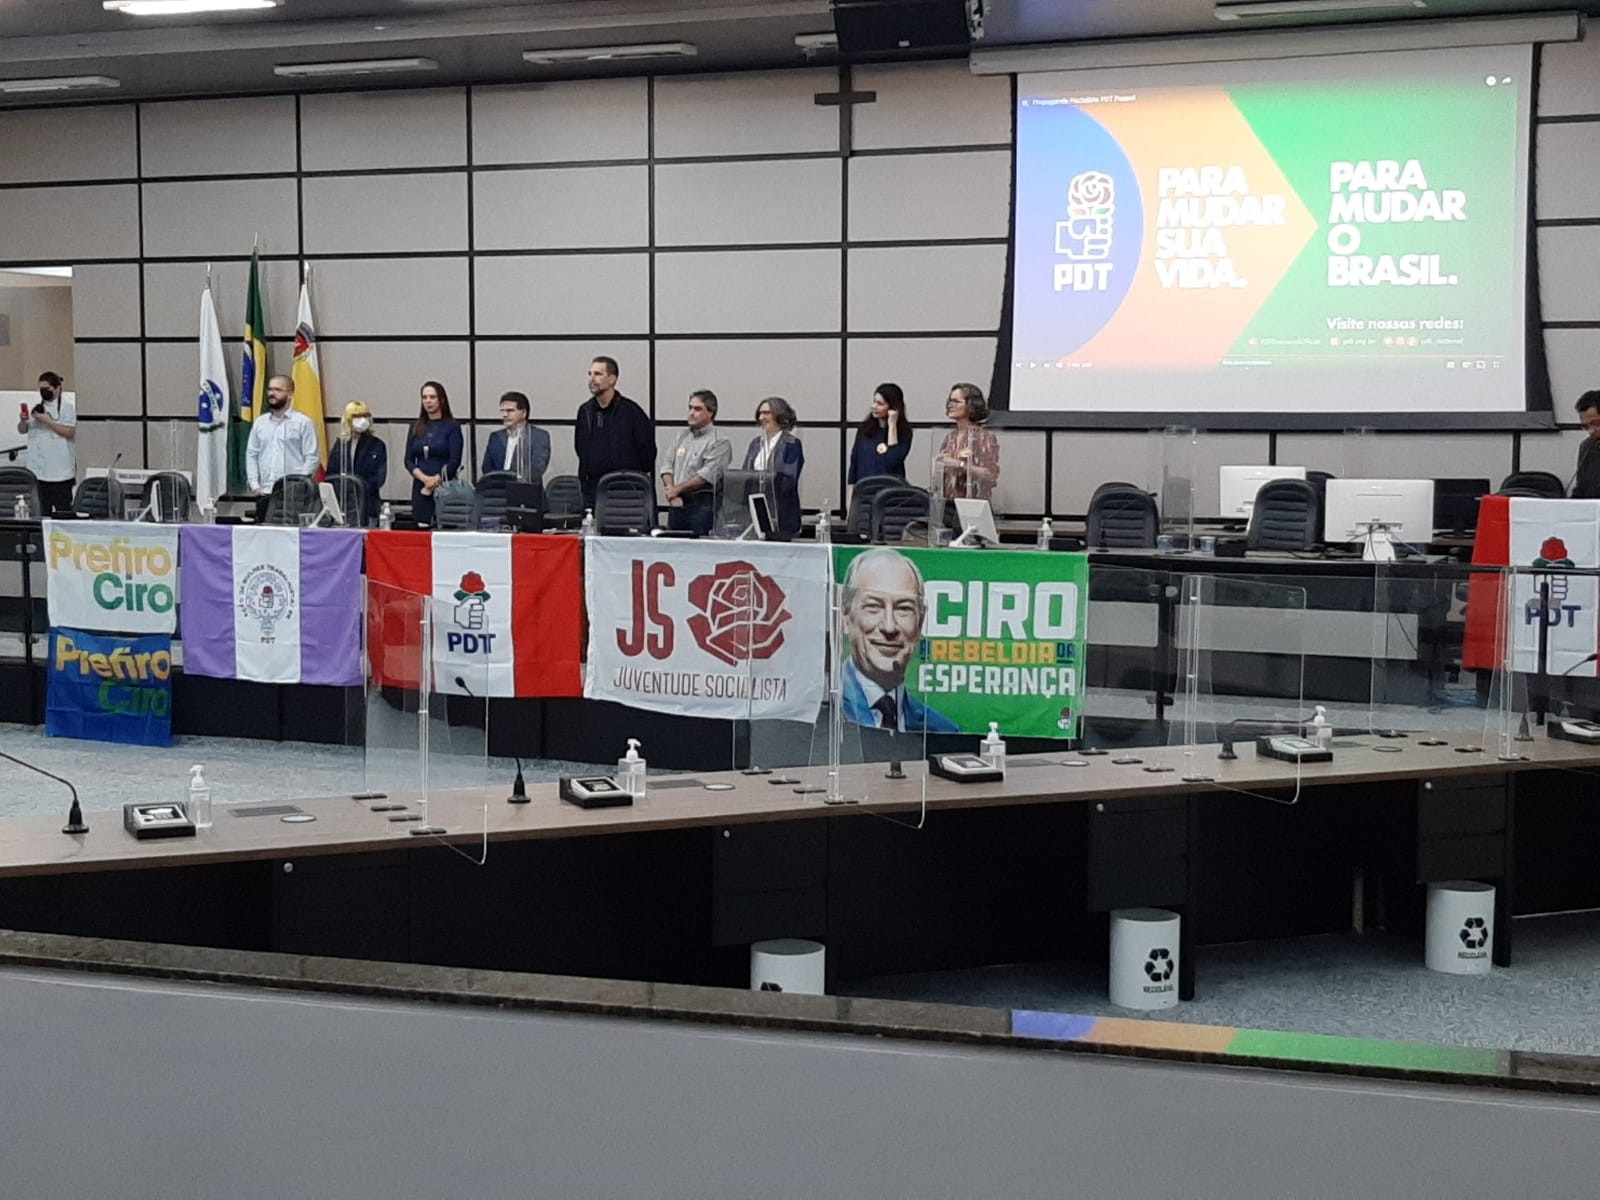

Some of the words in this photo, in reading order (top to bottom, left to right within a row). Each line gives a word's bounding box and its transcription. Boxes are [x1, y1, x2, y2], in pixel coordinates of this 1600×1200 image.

[1158, 165, 1249, 197] PARA
[1330, 159, 1427, 192] PARA
[1156, 194, 1287, 228] MUDAR
[1328, 189, 1466, 223] MUDAR
[1155, 227, 1227, 258] SUA
[1327, 223, 1361, 255] O
[1053, 262, 1113, 292] PDT
[1153, 257, 1248, 288] VIDA.
[1327, 253, 1458, 287] BRASIL.
[1327, 318, 1364, 330] Visite
[1368, 318, 1416, 330] nossas
[1419, 315, 1464, 330] redes:
[50, 533, 172, 577] Prefiro
[93, 573, 174, 614] Ciro
[615, 558, 676, 661] JS
[922, 580, 1078, 640] CIRO
[55, 634, 172, 681] Prefiro
[447, 631, 496, 655] PDT
[931, 640, 1056, 664] REBELDIA
[96, 676, 169, 717] Ciro
[613, 665, 701, 697] JUVENTUDE
[705, 675, 788, 702] SOCIALISTA
[918, 663, 1076, 699] ESPERANÇA
